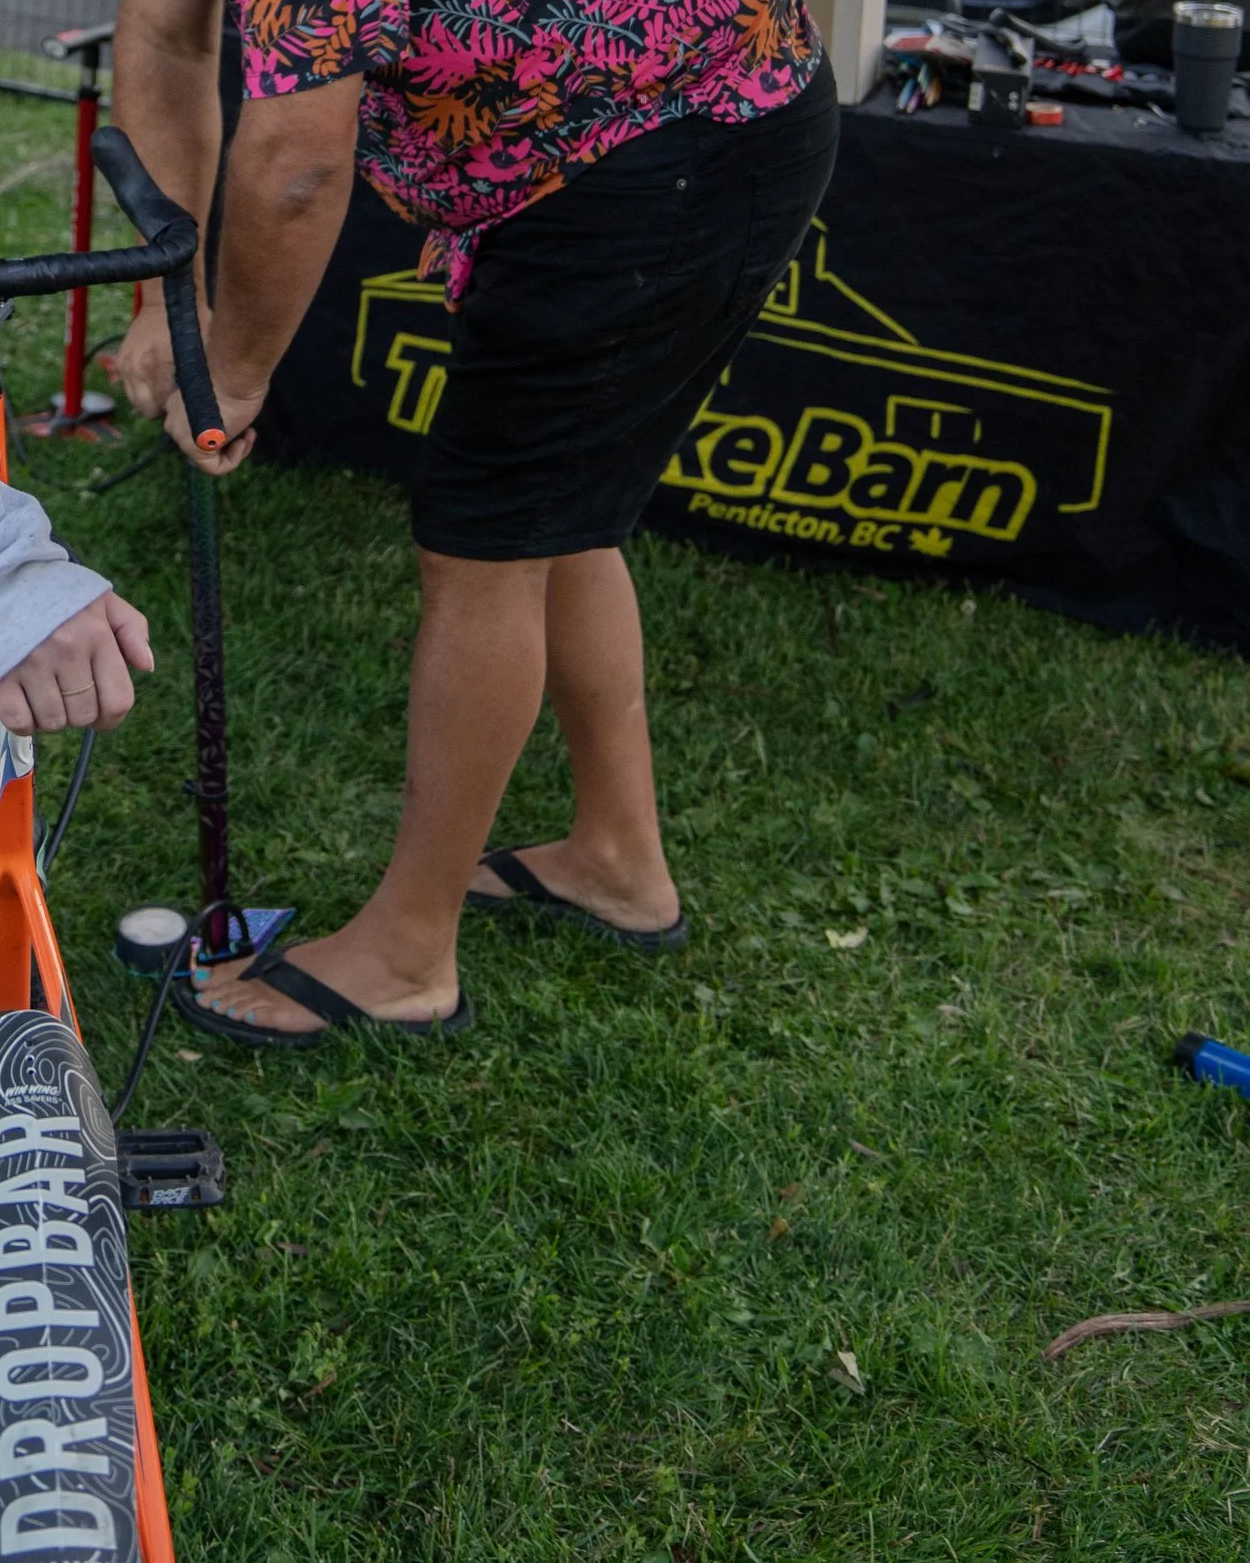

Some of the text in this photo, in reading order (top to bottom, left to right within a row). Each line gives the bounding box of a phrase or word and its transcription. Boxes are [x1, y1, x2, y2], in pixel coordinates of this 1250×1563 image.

[688, 492, 903, 551] Penticton, BC
[769, 406, 1037, 542] Barn
